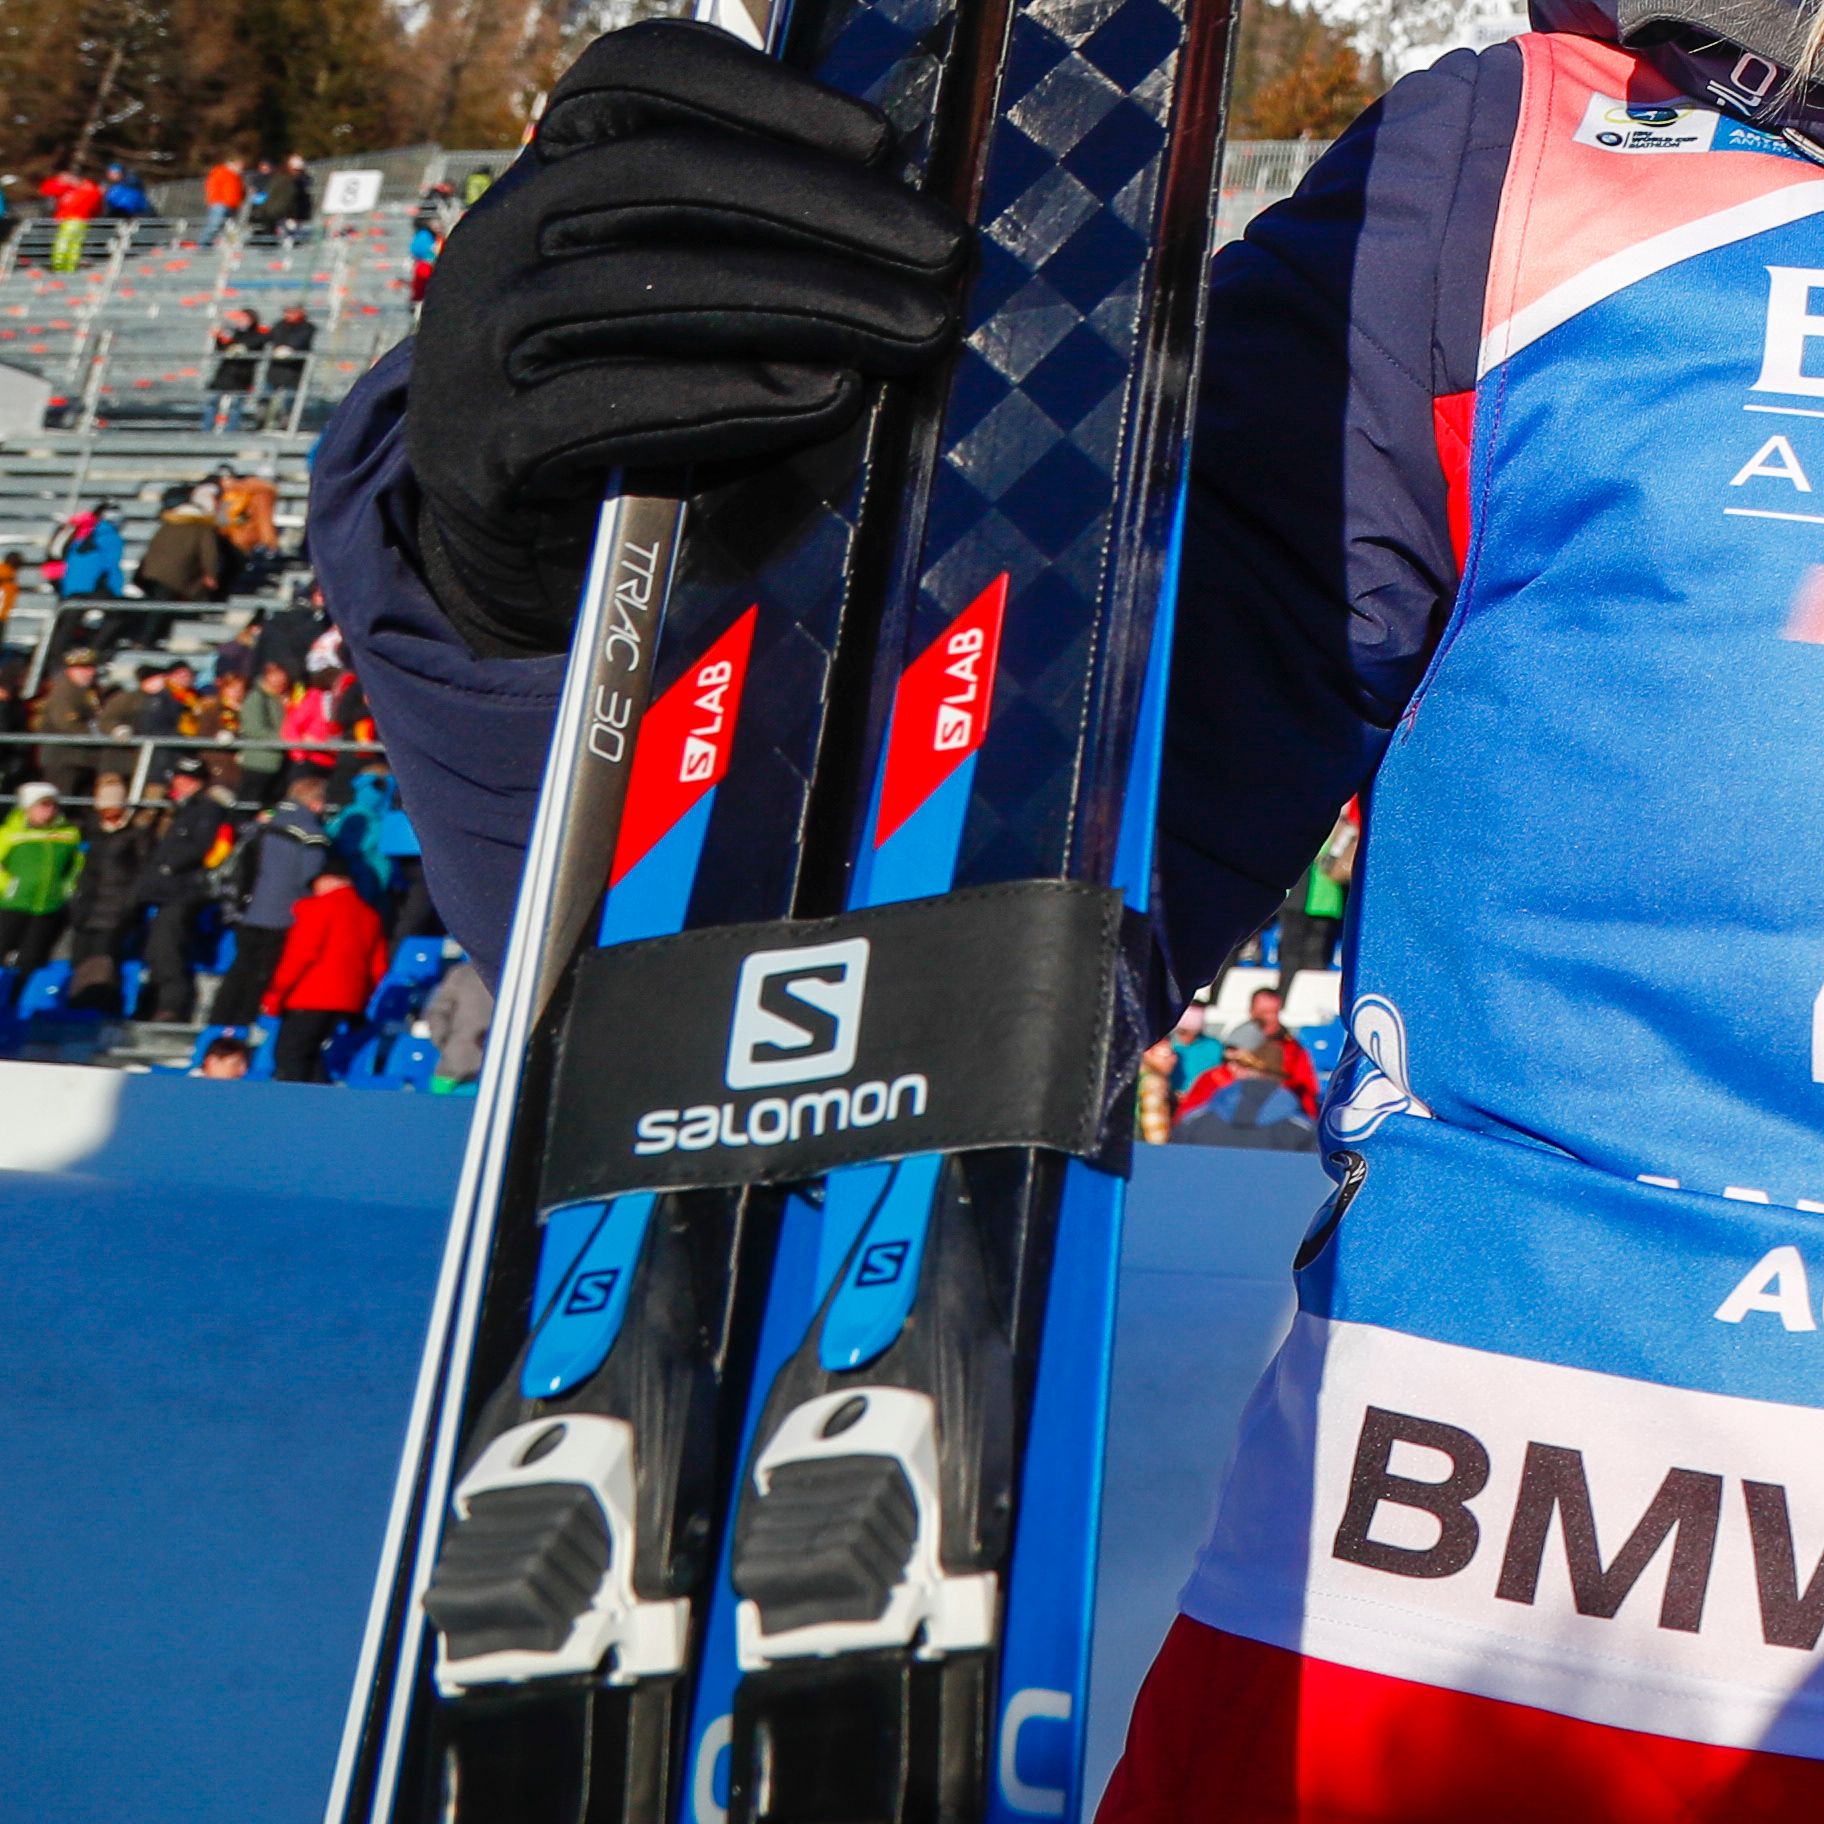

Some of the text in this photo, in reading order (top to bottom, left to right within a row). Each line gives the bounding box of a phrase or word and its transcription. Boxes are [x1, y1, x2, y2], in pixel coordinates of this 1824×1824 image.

[605, 540, 660, 672] TRIAC
[690, 659, 733, 736] LAB
[942, 626, 984, 705] LAB
[633, 1072, 929, 1156] salomon
